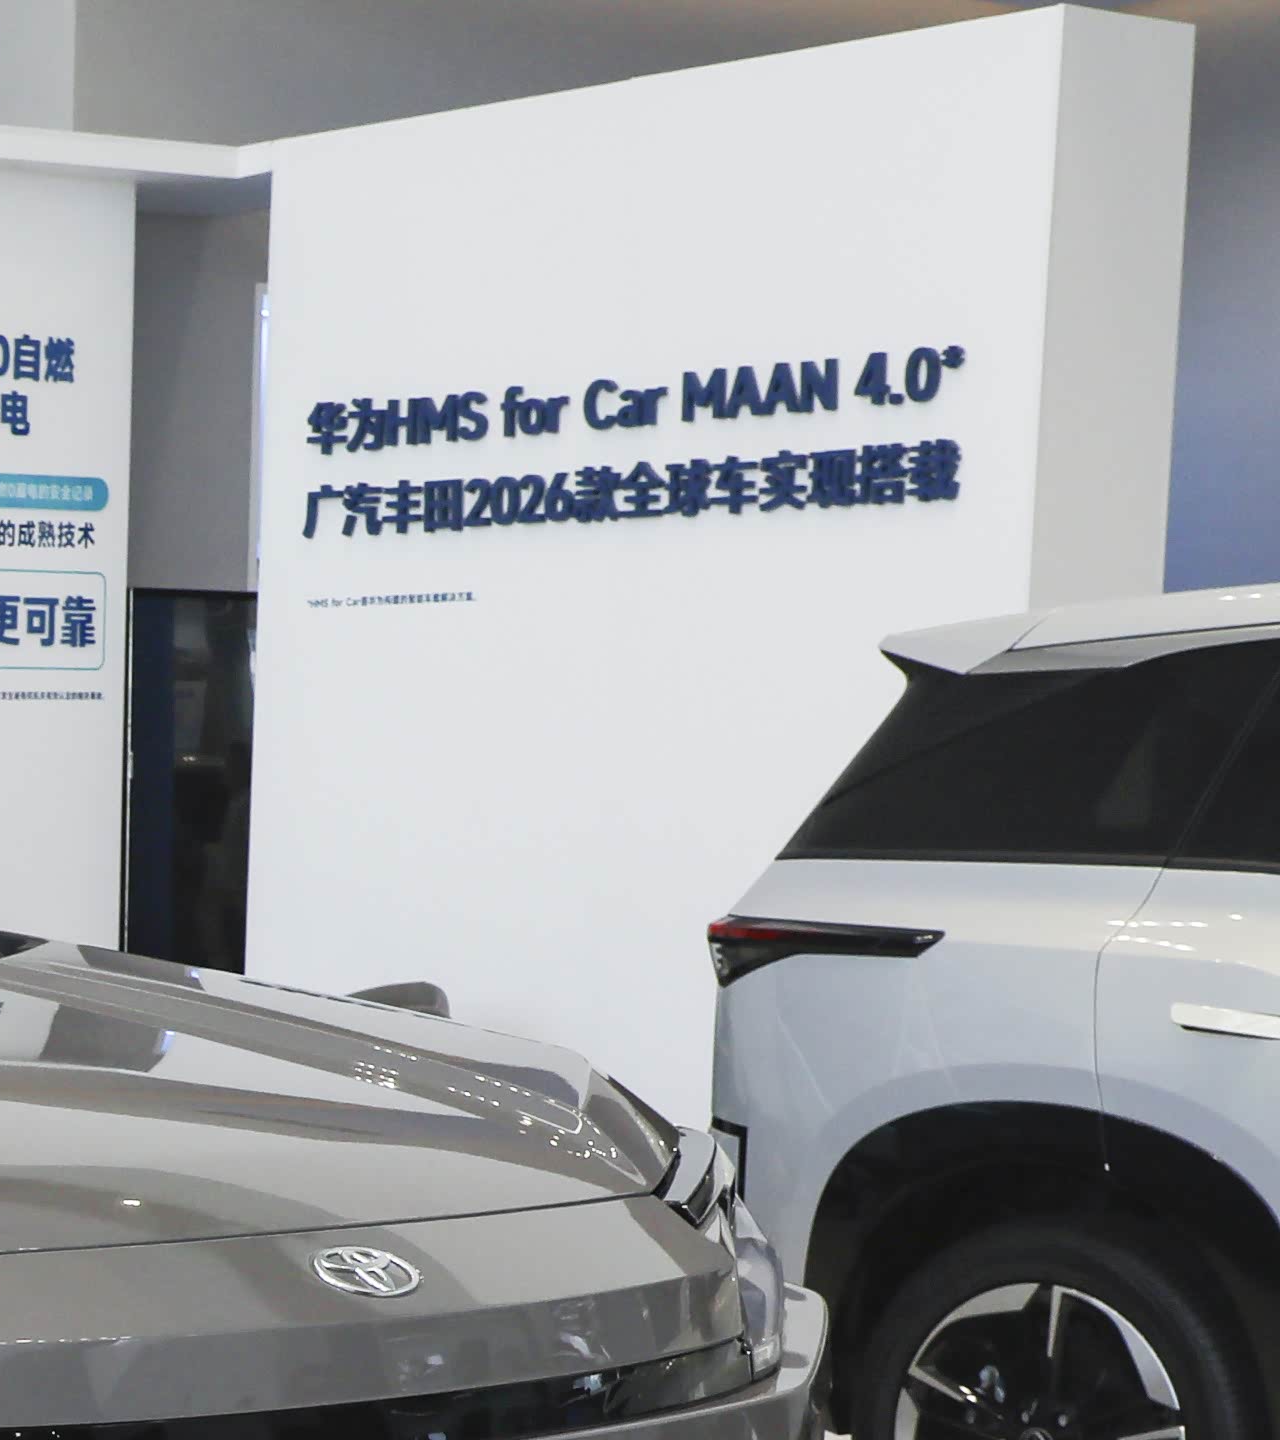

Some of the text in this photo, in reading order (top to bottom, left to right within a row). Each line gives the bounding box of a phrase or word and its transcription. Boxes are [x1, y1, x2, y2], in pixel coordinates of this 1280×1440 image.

[307, 389, 489, 454] 华为HMS
[502, 385, 570, 438] for
[583, 378, 668, 431] Car
[681, 357, 839, 423] MAAN
[301, 438, 962, 540] 广汽丰田2026款全球车实现搭载
